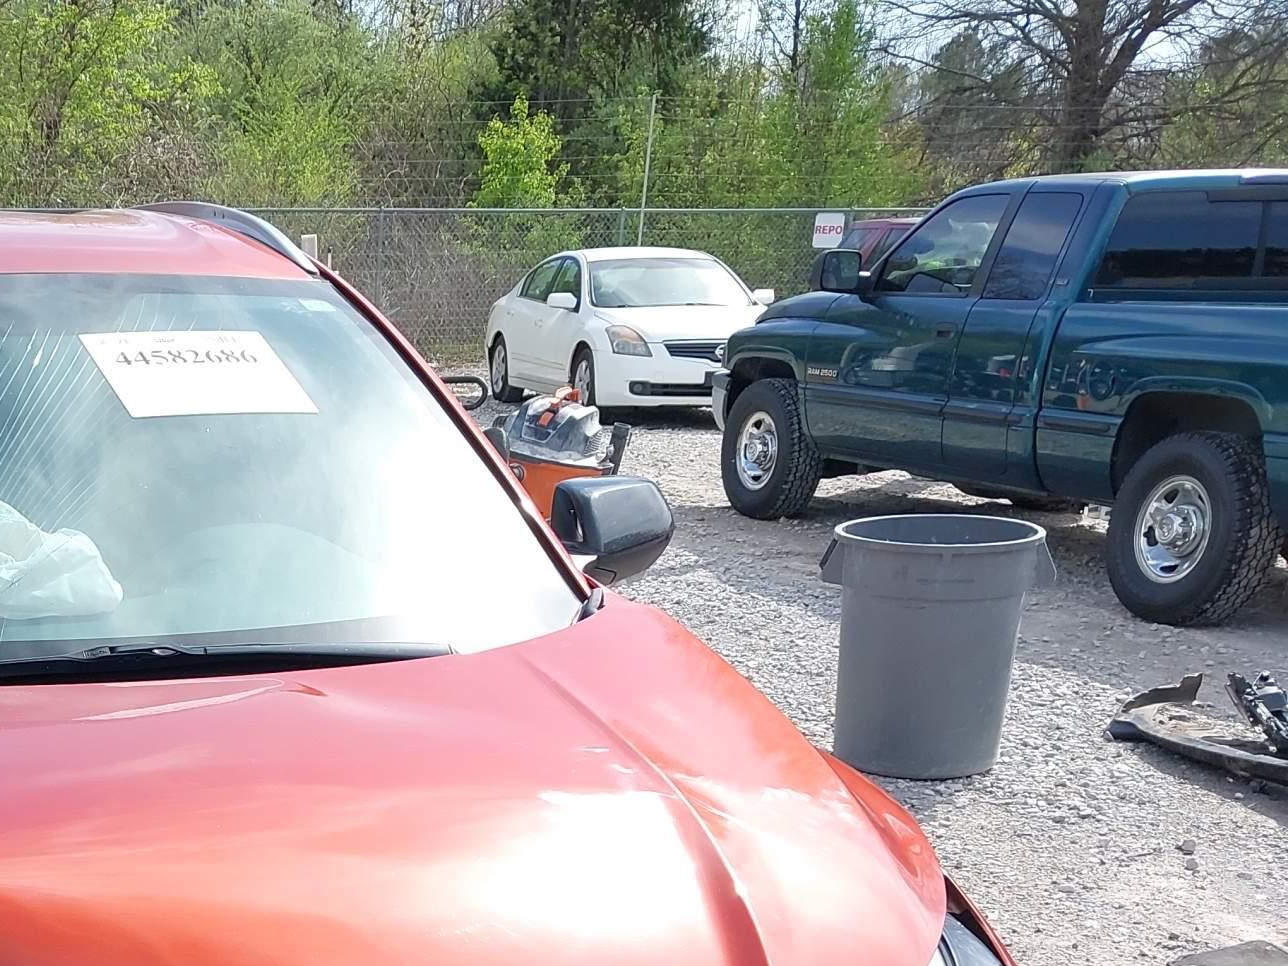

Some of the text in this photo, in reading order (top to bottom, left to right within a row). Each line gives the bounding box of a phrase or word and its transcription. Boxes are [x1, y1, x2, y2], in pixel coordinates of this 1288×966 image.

[815, 225, 843, 235] REPO
[115, 348, 259, 367] 44582686
[808, 367, 838, 378] RAM 2500
